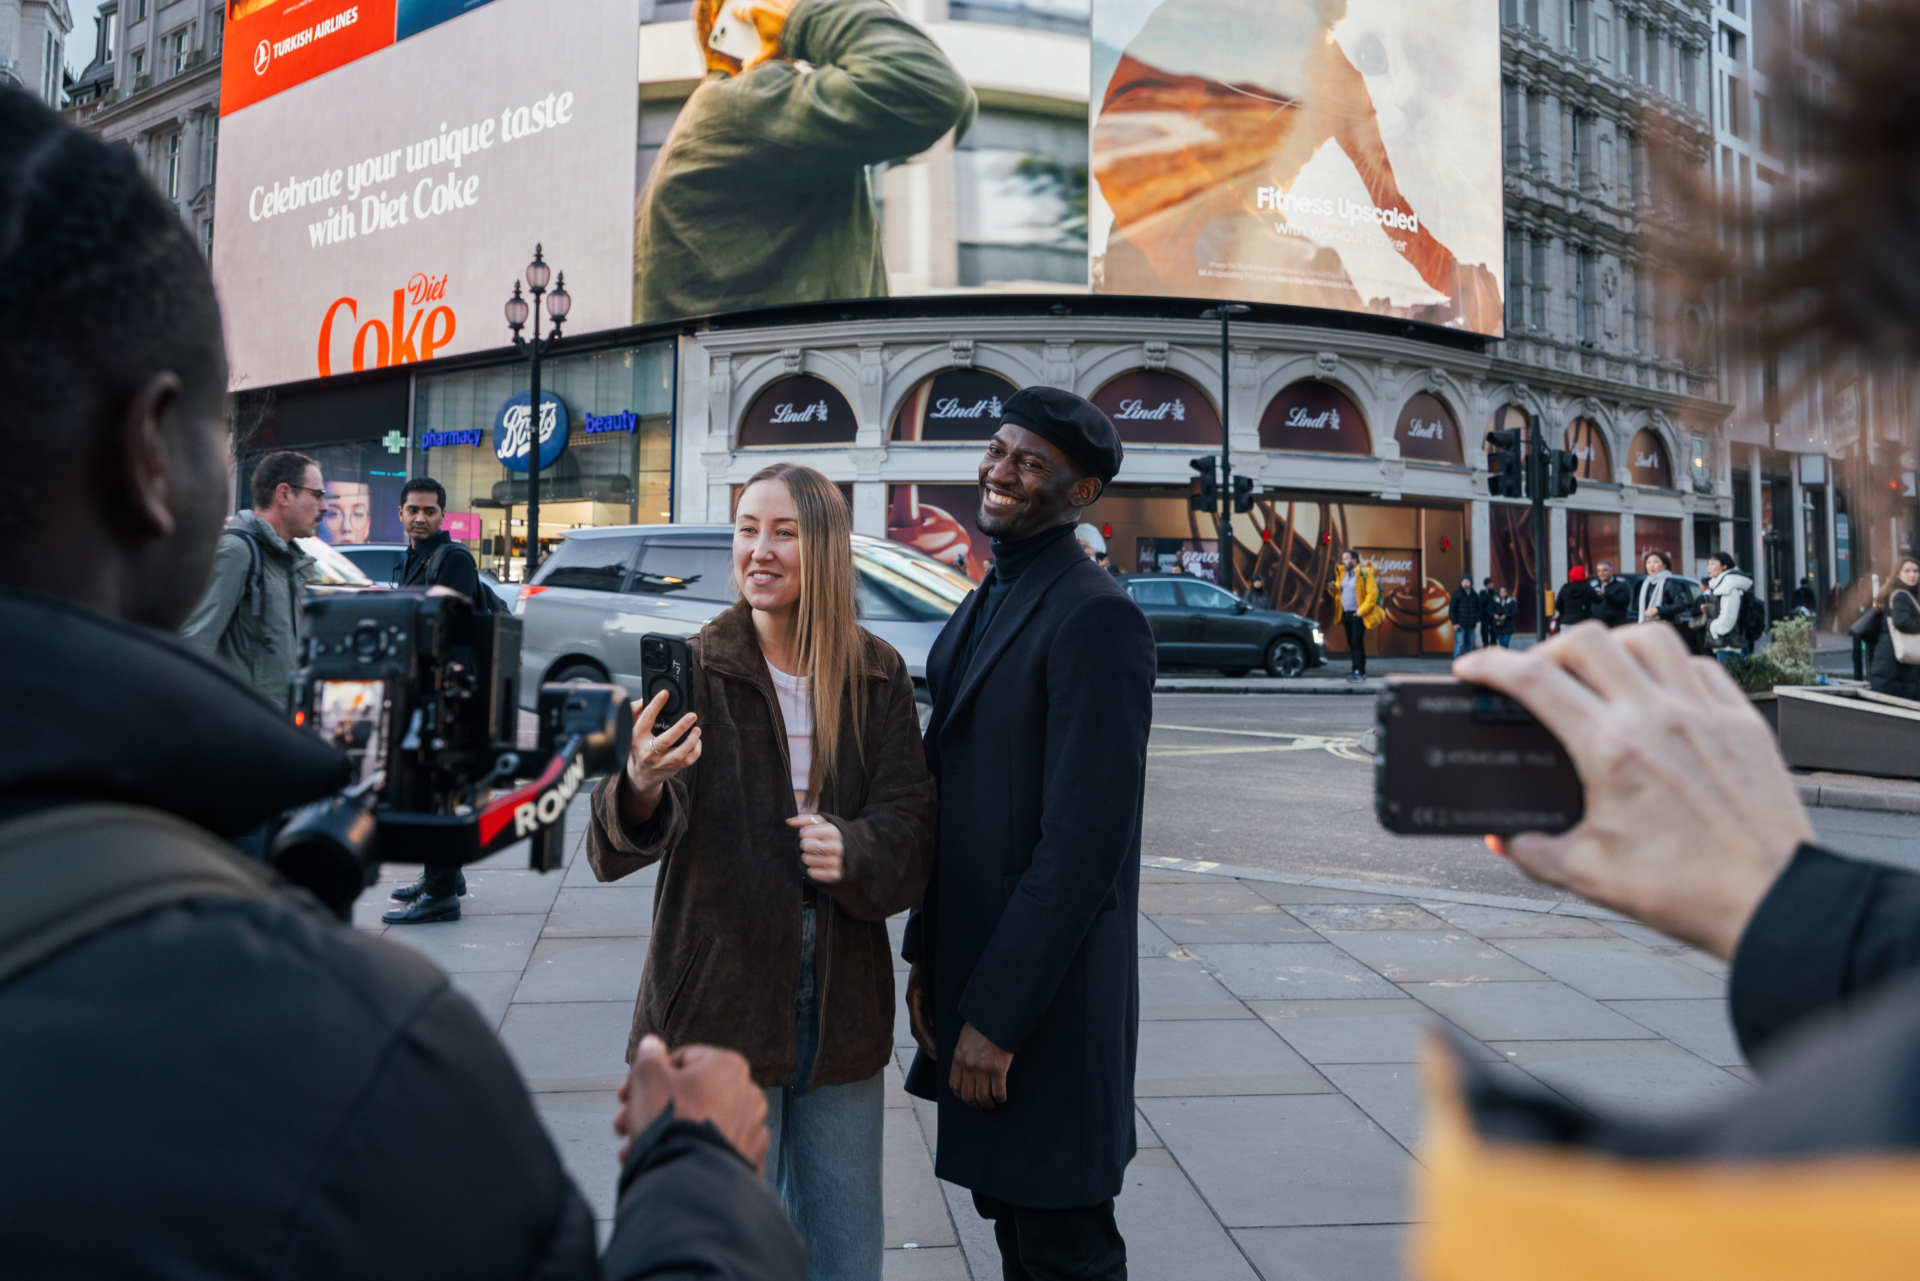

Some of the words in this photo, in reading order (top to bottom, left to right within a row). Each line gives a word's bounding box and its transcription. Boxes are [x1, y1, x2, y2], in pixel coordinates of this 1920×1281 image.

[273, 27, 313, 59] TURKISH
[314, 6, 359, 40] AIRLINES
[249, 168, 343, 222] Celebrate
[347, 149, 402, 200] your
[406, 117, 495, 172] unique
[501, 91, 574, 143] taste
[309, 206, 356, 249] with
[361, 190, 408, 235] Diet
[413, 172, 480, 220] Coke
[1257, 186, 1334, 217] Fitness
[1337, 197, 1418, 233] Upscaled
[1275, 221, 1307, 237] with
[1309, 223, 1365, 244] Workout
[1366, 231, 1408, 252] Tracker
[407, 272, 448, 306] Diet
[317, 288, 457, 378] Coke
[770, 403, 817, 424] Lindt
[929, 398, 989, 419] Lindt
[1113, 399, 1171, 421] Lindt
[1284, 407, 1329, 430] Lindt
[585, 409, 638, 434] beauty
[1407, 417, 1436, 440] Lindt
[421, 428, 483, 452] pharmacy
[1634, 450, 1653, 467] Lindt
[1359, 554, 1413, 575] dulgence
[514, 753, 585, 838] RONIN
